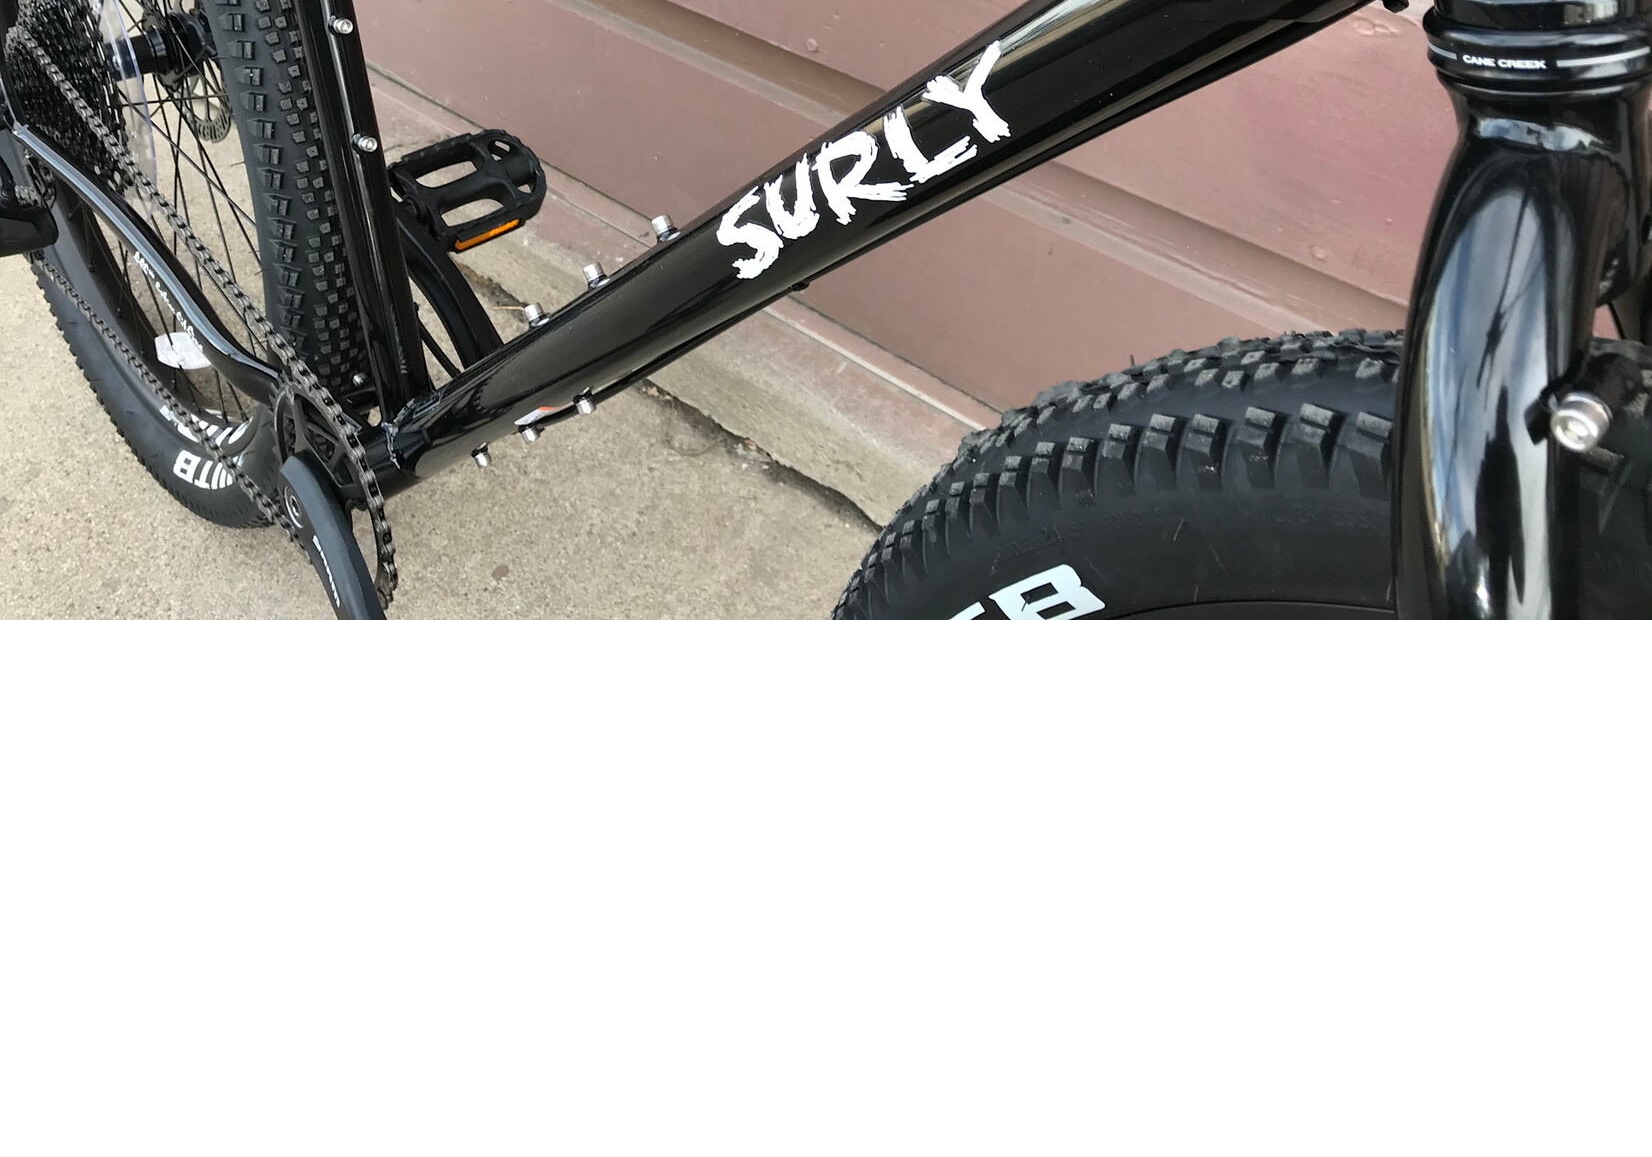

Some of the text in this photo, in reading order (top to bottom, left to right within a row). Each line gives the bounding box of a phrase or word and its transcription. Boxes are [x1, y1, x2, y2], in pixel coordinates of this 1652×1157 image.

[1462, 54, 1547, 70] CANE CREEK
[716, 40, 1011, 279] SURLY
